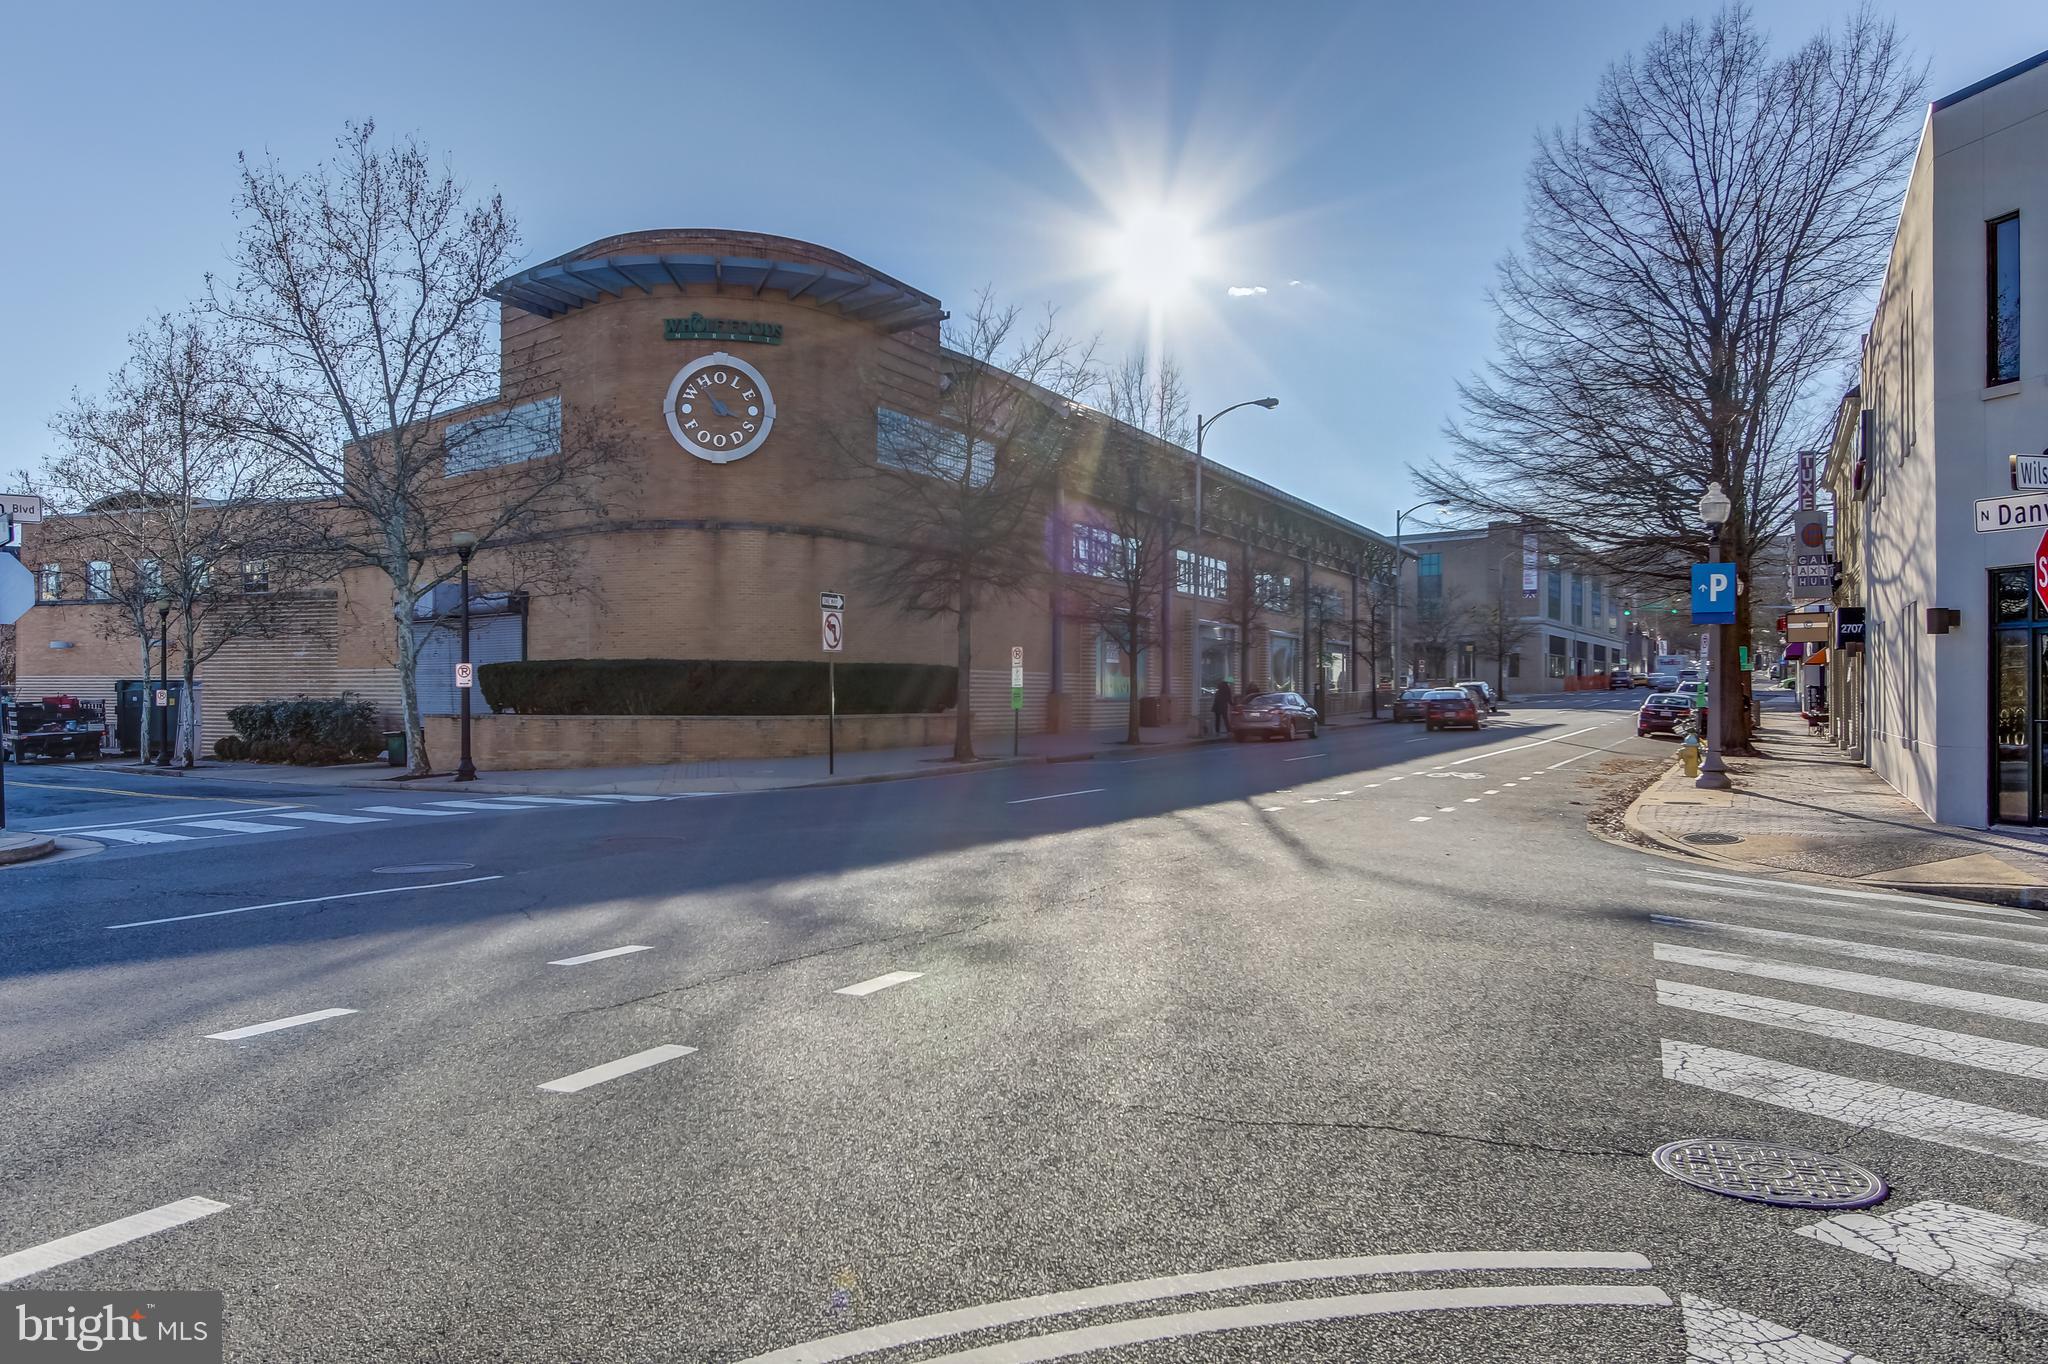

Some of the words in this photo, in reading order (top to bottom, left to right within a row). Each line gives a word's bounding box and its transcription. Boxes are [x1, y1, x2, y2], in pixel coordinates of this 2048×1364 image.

[666, 314, 724, 333] WHOLE
[729, 321, 783, 337] FOODS
[674, 332, 771, 343] MARKET
[682, 371, 756, 401] WHOLE
[684, 418, 755, 447] FOODS
[12, 503, 35, 514] Blvd
[1981, 510, 1990, 522] N
[1800, 567, 1827, 575] AXY
[1800, 577, 1827, 586] HUT
[1710, 574, 1728, 601] P
[1841, 624, 1863, 633] 2707
